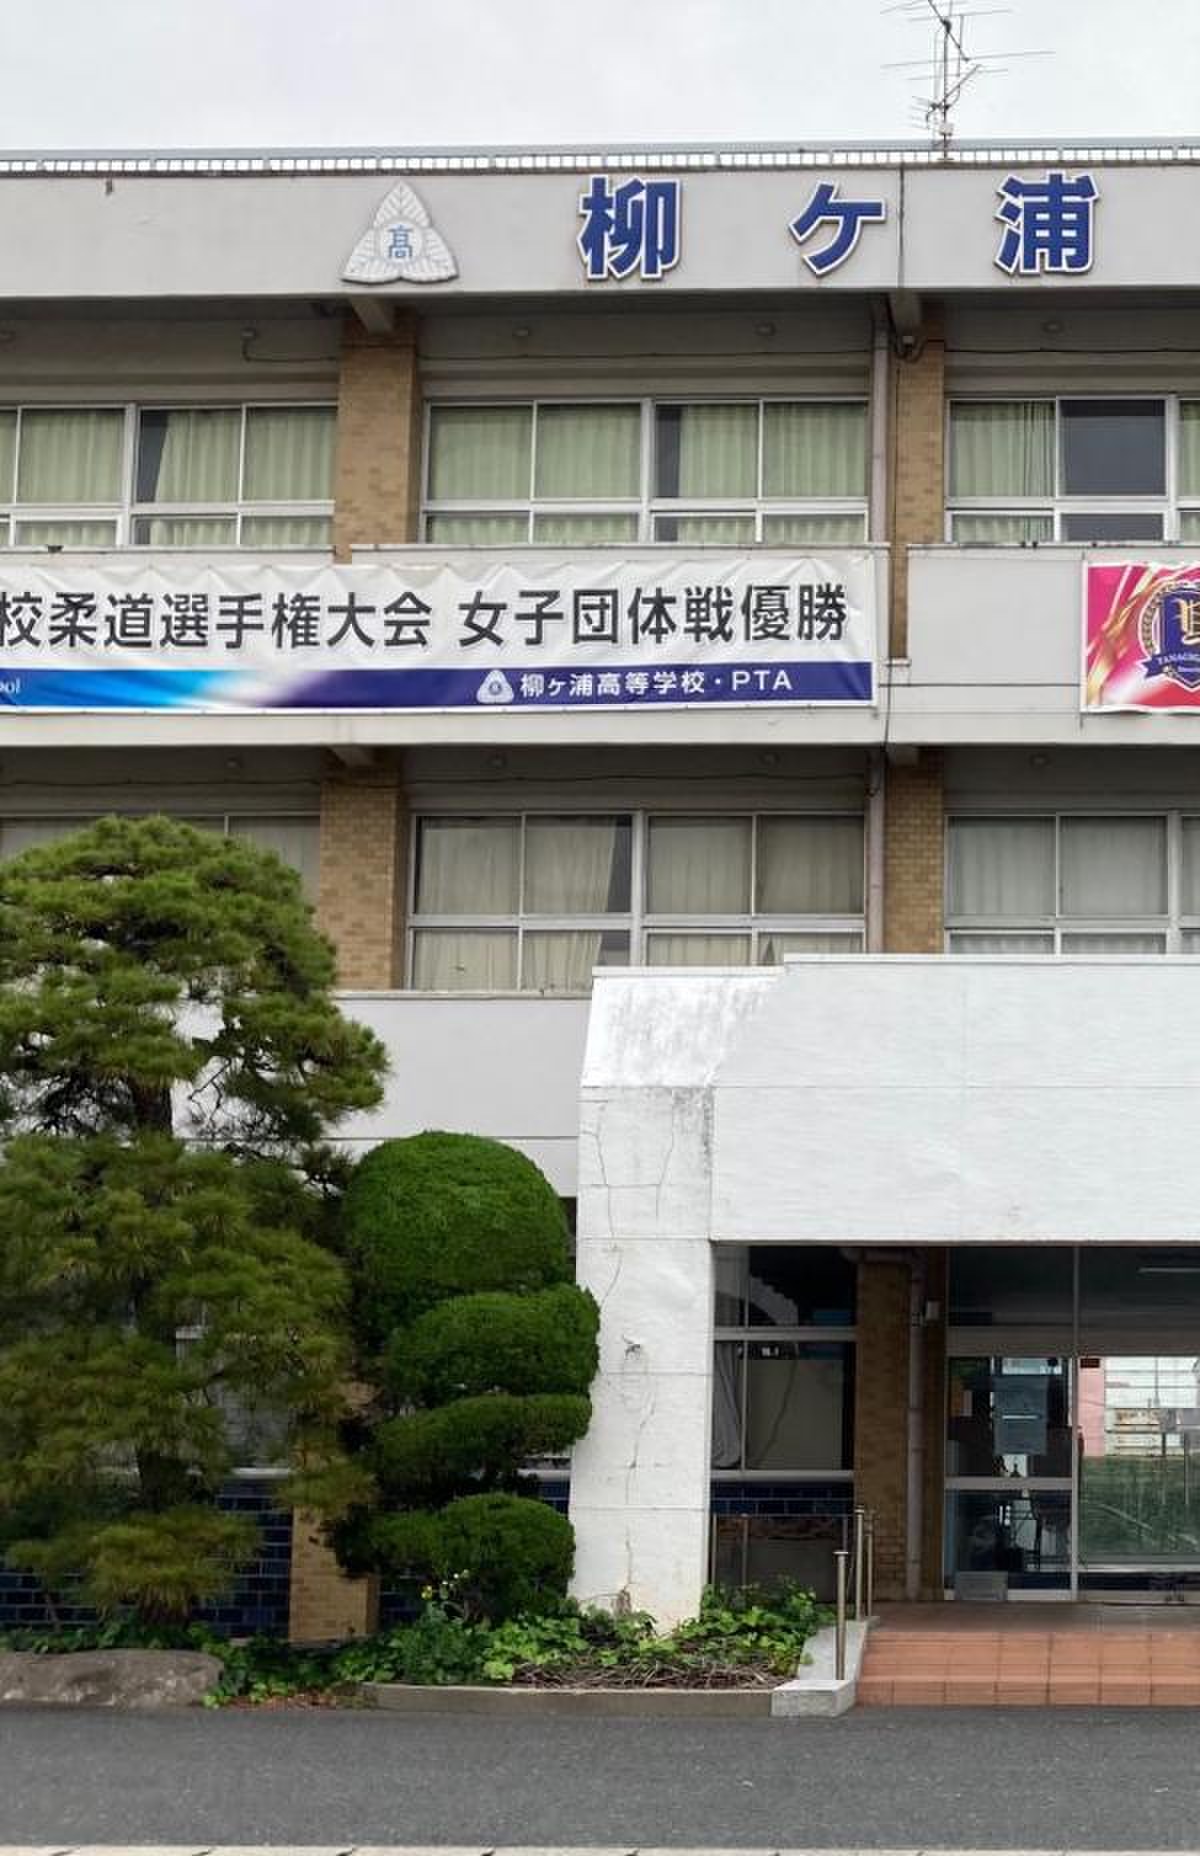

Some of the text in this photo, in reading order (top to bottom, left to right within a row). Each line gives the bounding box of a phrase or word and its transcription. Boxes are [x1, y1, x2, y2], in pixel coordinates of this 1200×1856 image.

[458, 583, 848, 648] 女子団体戦優勝
